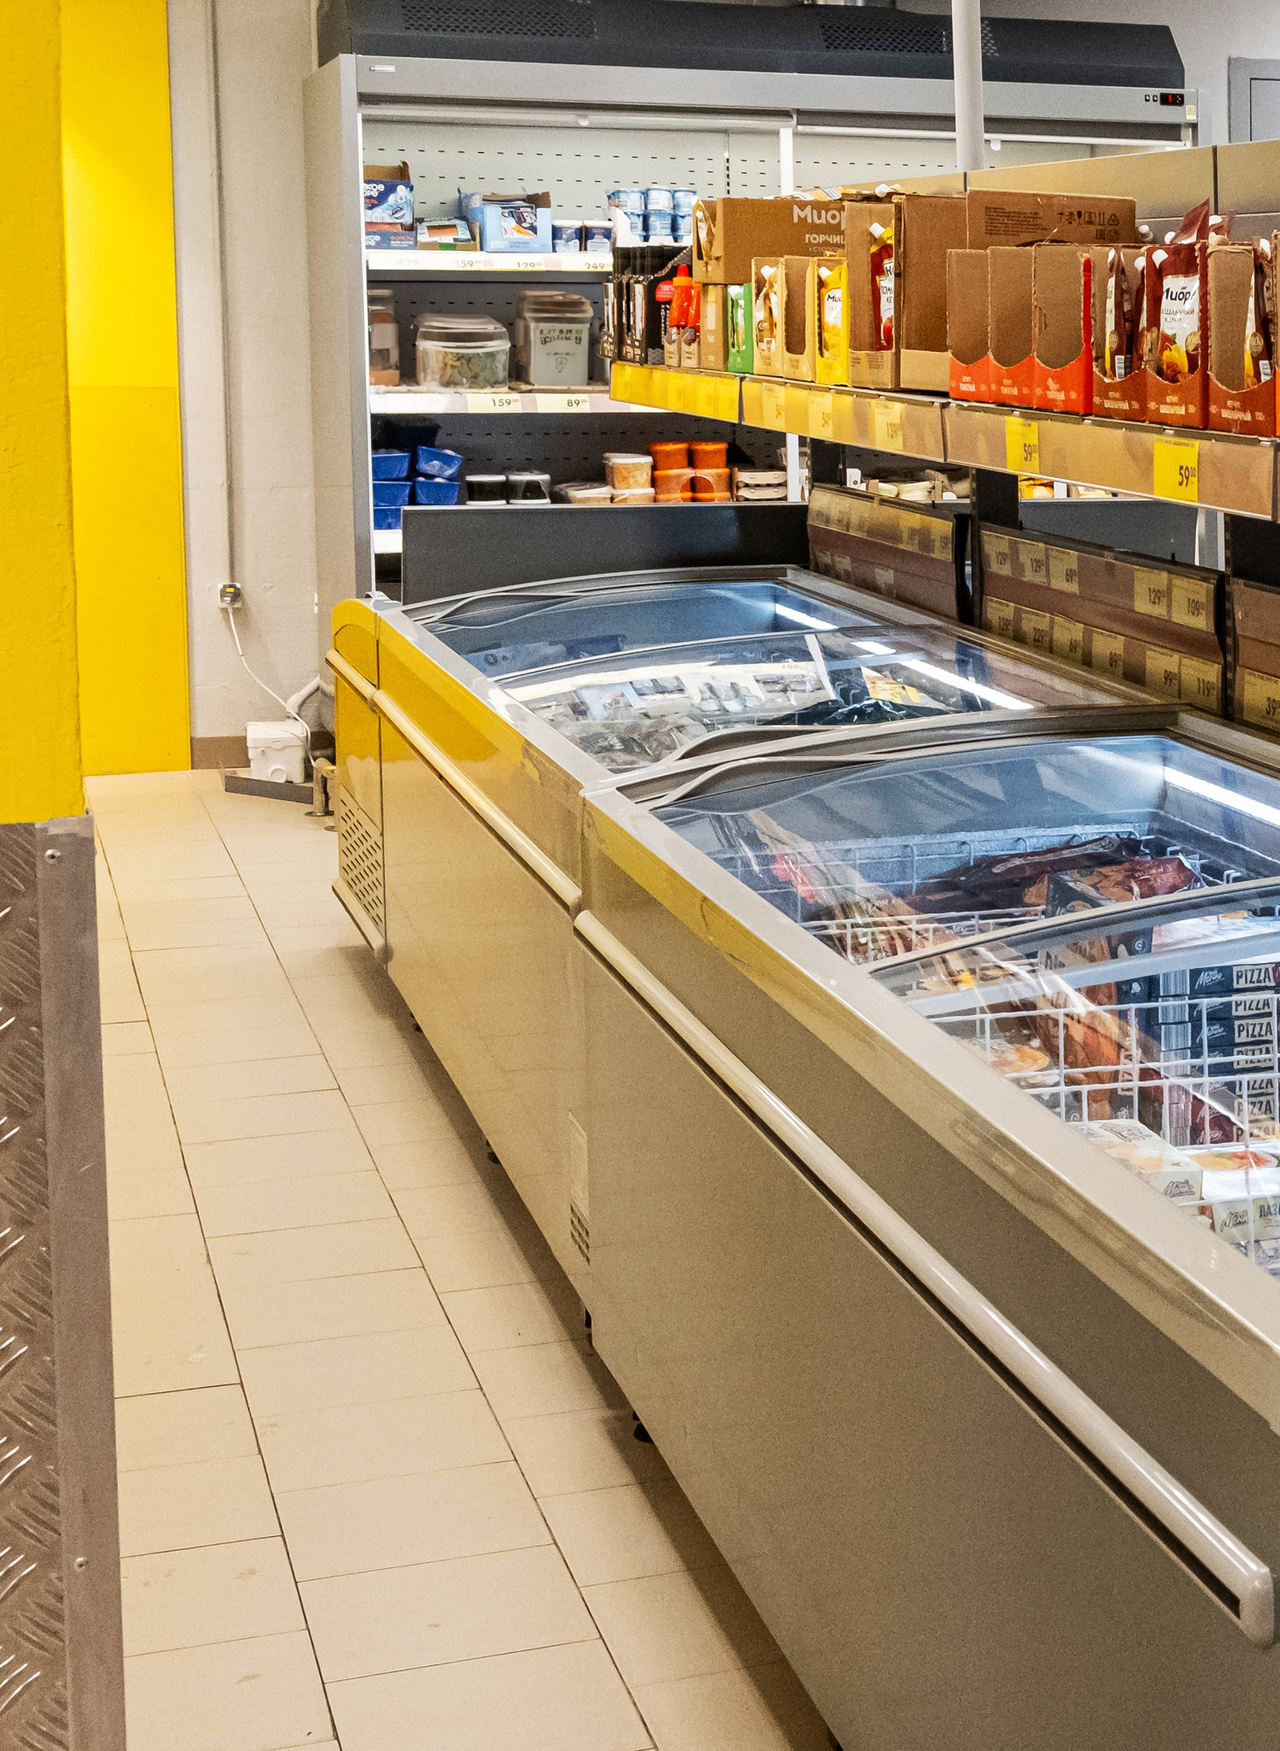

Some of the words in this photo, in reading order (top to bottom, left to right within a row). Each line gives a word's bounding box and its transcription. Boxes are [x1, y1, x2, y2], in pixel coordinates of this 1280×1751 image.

[492, 399, 512, 407] 159
[567, 399, 581, 407] 89
[1178, 465, 1190, 487] 59
[1236, 968, 1271, 985] PIZZA
[1238, 1022, 1273, 1038] PIZZA
